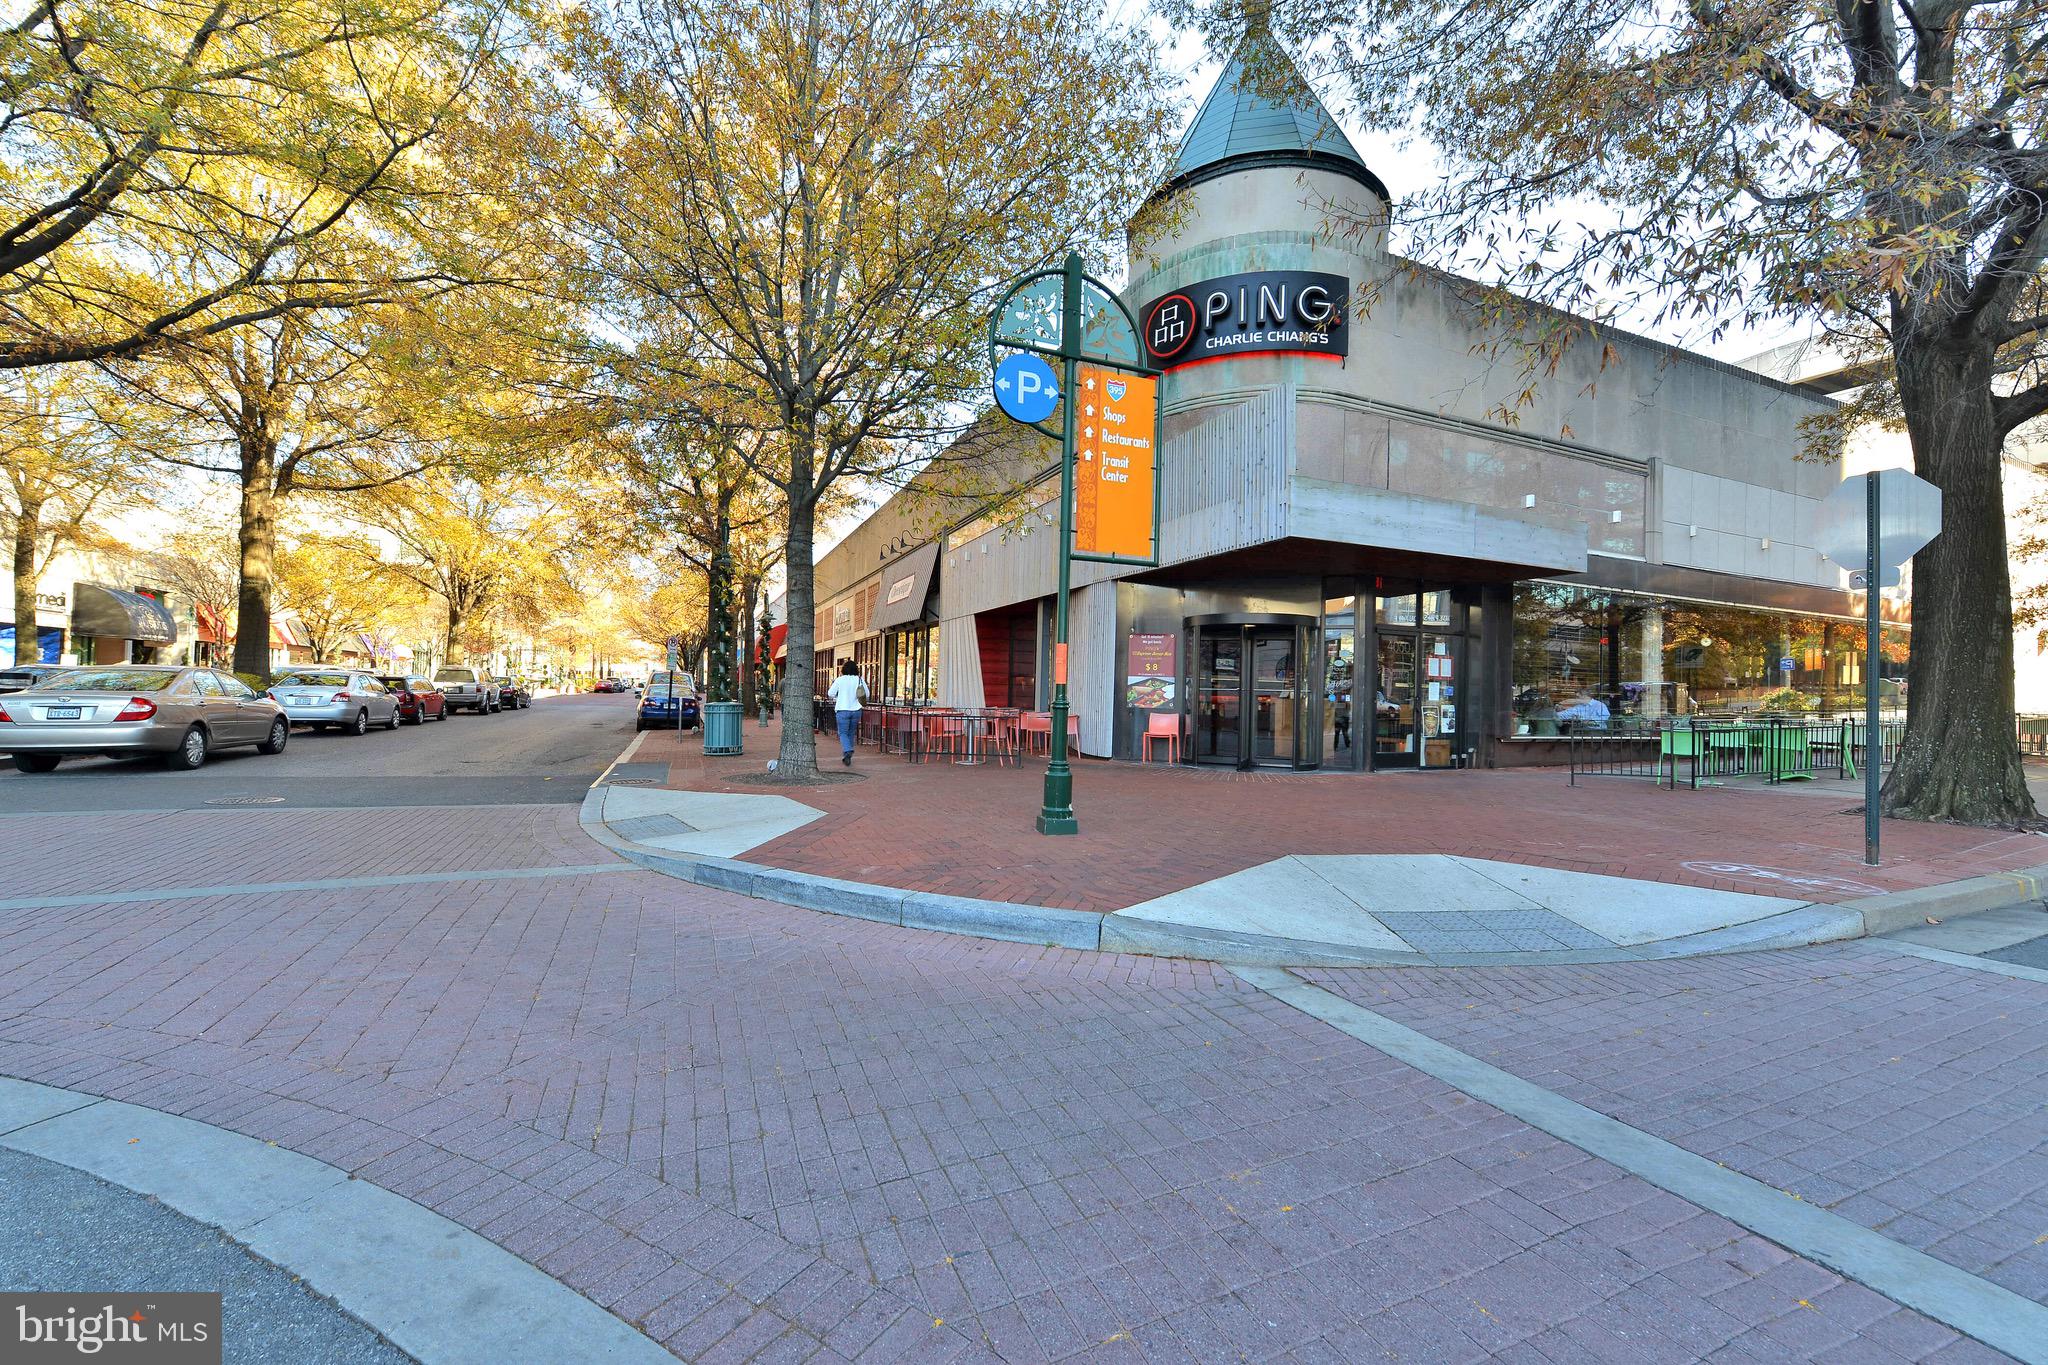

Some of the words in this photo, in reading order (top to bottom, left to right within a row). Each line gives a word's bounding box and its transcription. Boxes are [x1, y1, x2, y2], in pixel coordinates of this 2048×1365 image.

[1204, 284, 1332, 330] PING
[1206, 332, 1263, 349] CHARLIE
[1017, 370, 1042, 405] P
[1109, 385, 1124, 395] 395
[1103, 406, 1126, 426] Shops
[1102, 428, 1150, 449] Restaurants
[1101, 451, 1130, 469] Transit
[1101, 466, 1129, 483] Center
